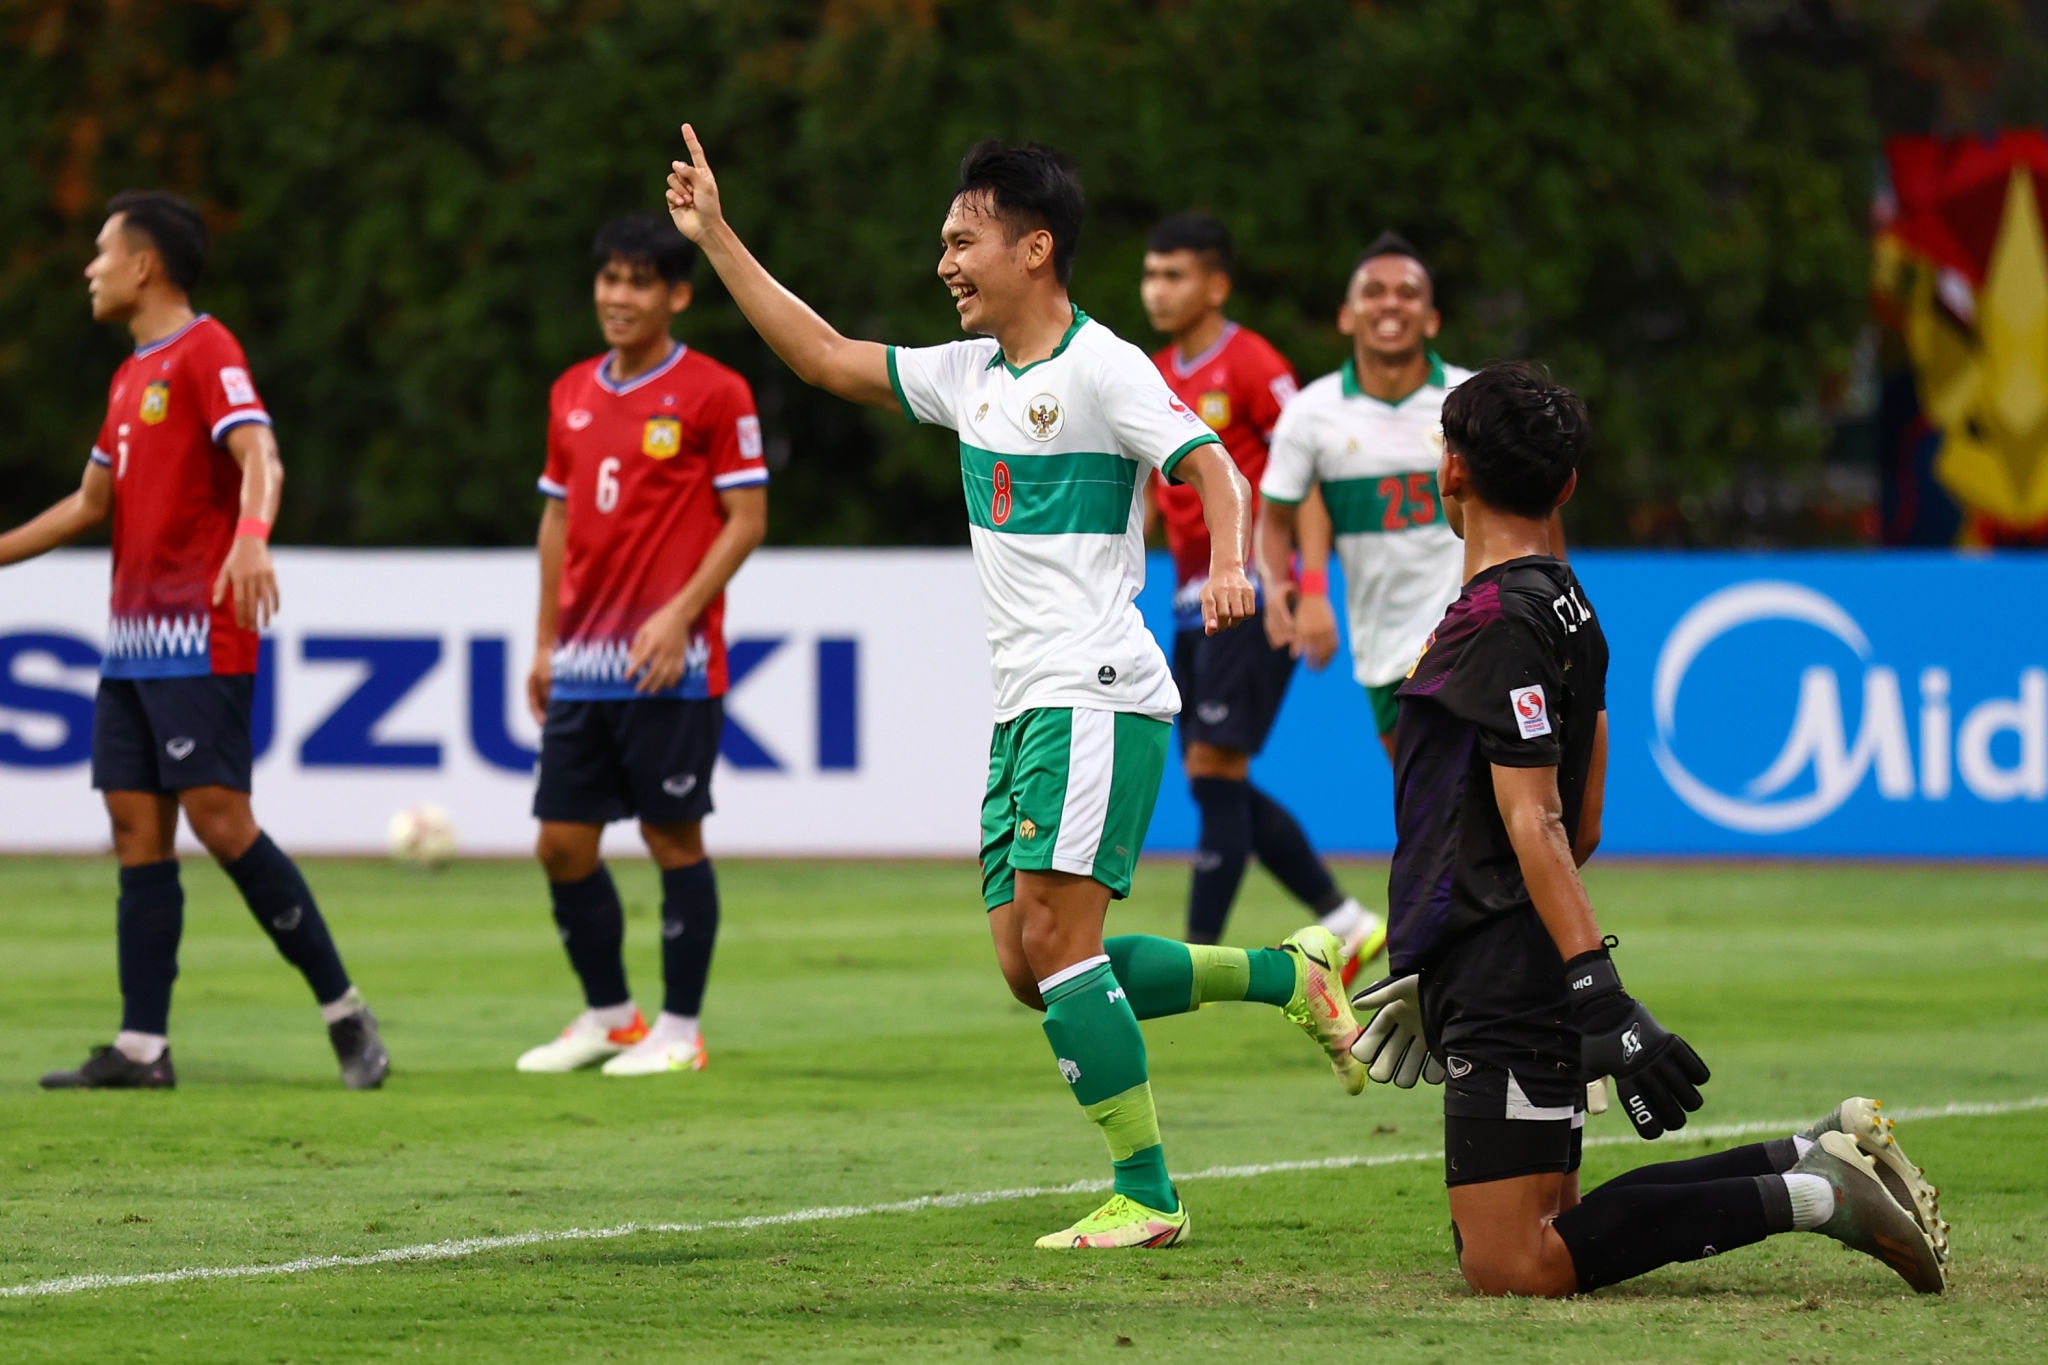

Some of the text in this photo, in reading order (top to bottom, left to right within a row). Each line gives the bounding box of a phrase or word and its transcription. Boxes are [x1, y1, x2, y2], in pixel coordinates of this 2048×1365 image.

[596, 456, 621, 514] 6
[991, 461, 1012, 526] 8
[1378, 473, 1436, 530] 25
[0, 630, 860, 773] SZUKI
[1572, 974, 1593, 991] Din
[1628, 1094, 1653, 1125] Din
